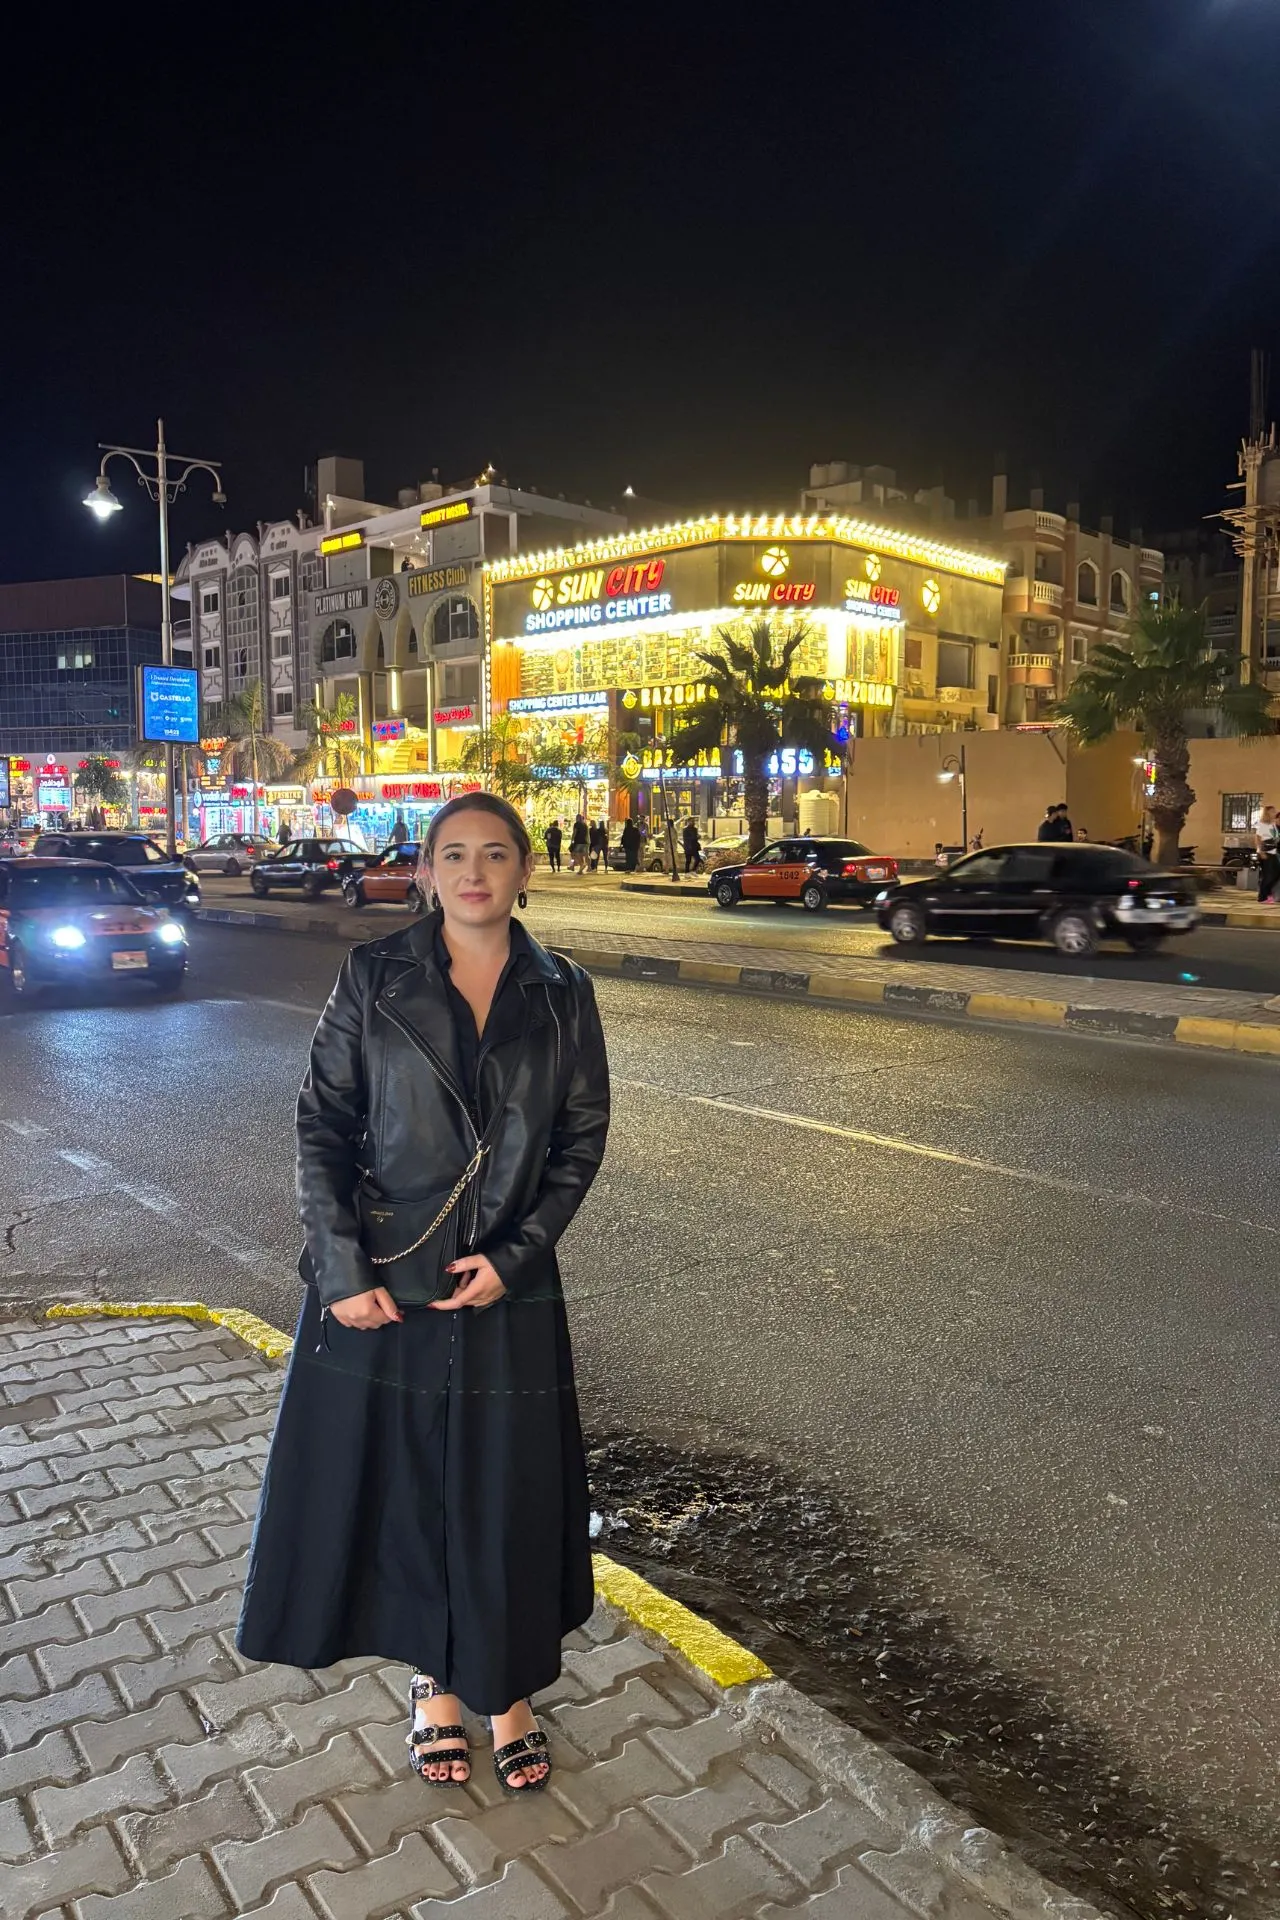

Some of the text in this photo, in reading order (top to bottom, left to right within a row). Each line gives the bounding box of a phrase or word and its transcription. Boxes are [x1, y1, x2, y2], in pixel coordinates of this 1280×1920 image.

[409, 566, 466, 596] FITNESS Club
[557, 559, 666, 604] SUN CITY
[733, 583, 815, 601] SUN CITY
[845, 579, 900, 606] SUN CITY
[315, 593, 346, 614] PLATINUM
[347, 589, 362, 608] GYM
[526, 593, 672, 631] SHOPPING CENTER
[509, 697, 546, 711] SHOPPING
[547, 693, 578, 708] CENTER
[835, 680, 893, 706] BAZOOKA
[35, 764, 69, 774] vodafone
[643, 747, 721, 768] BAZKA
[734, 748, 814, 774] 1455
[779, 871, 800, 880] 1642
